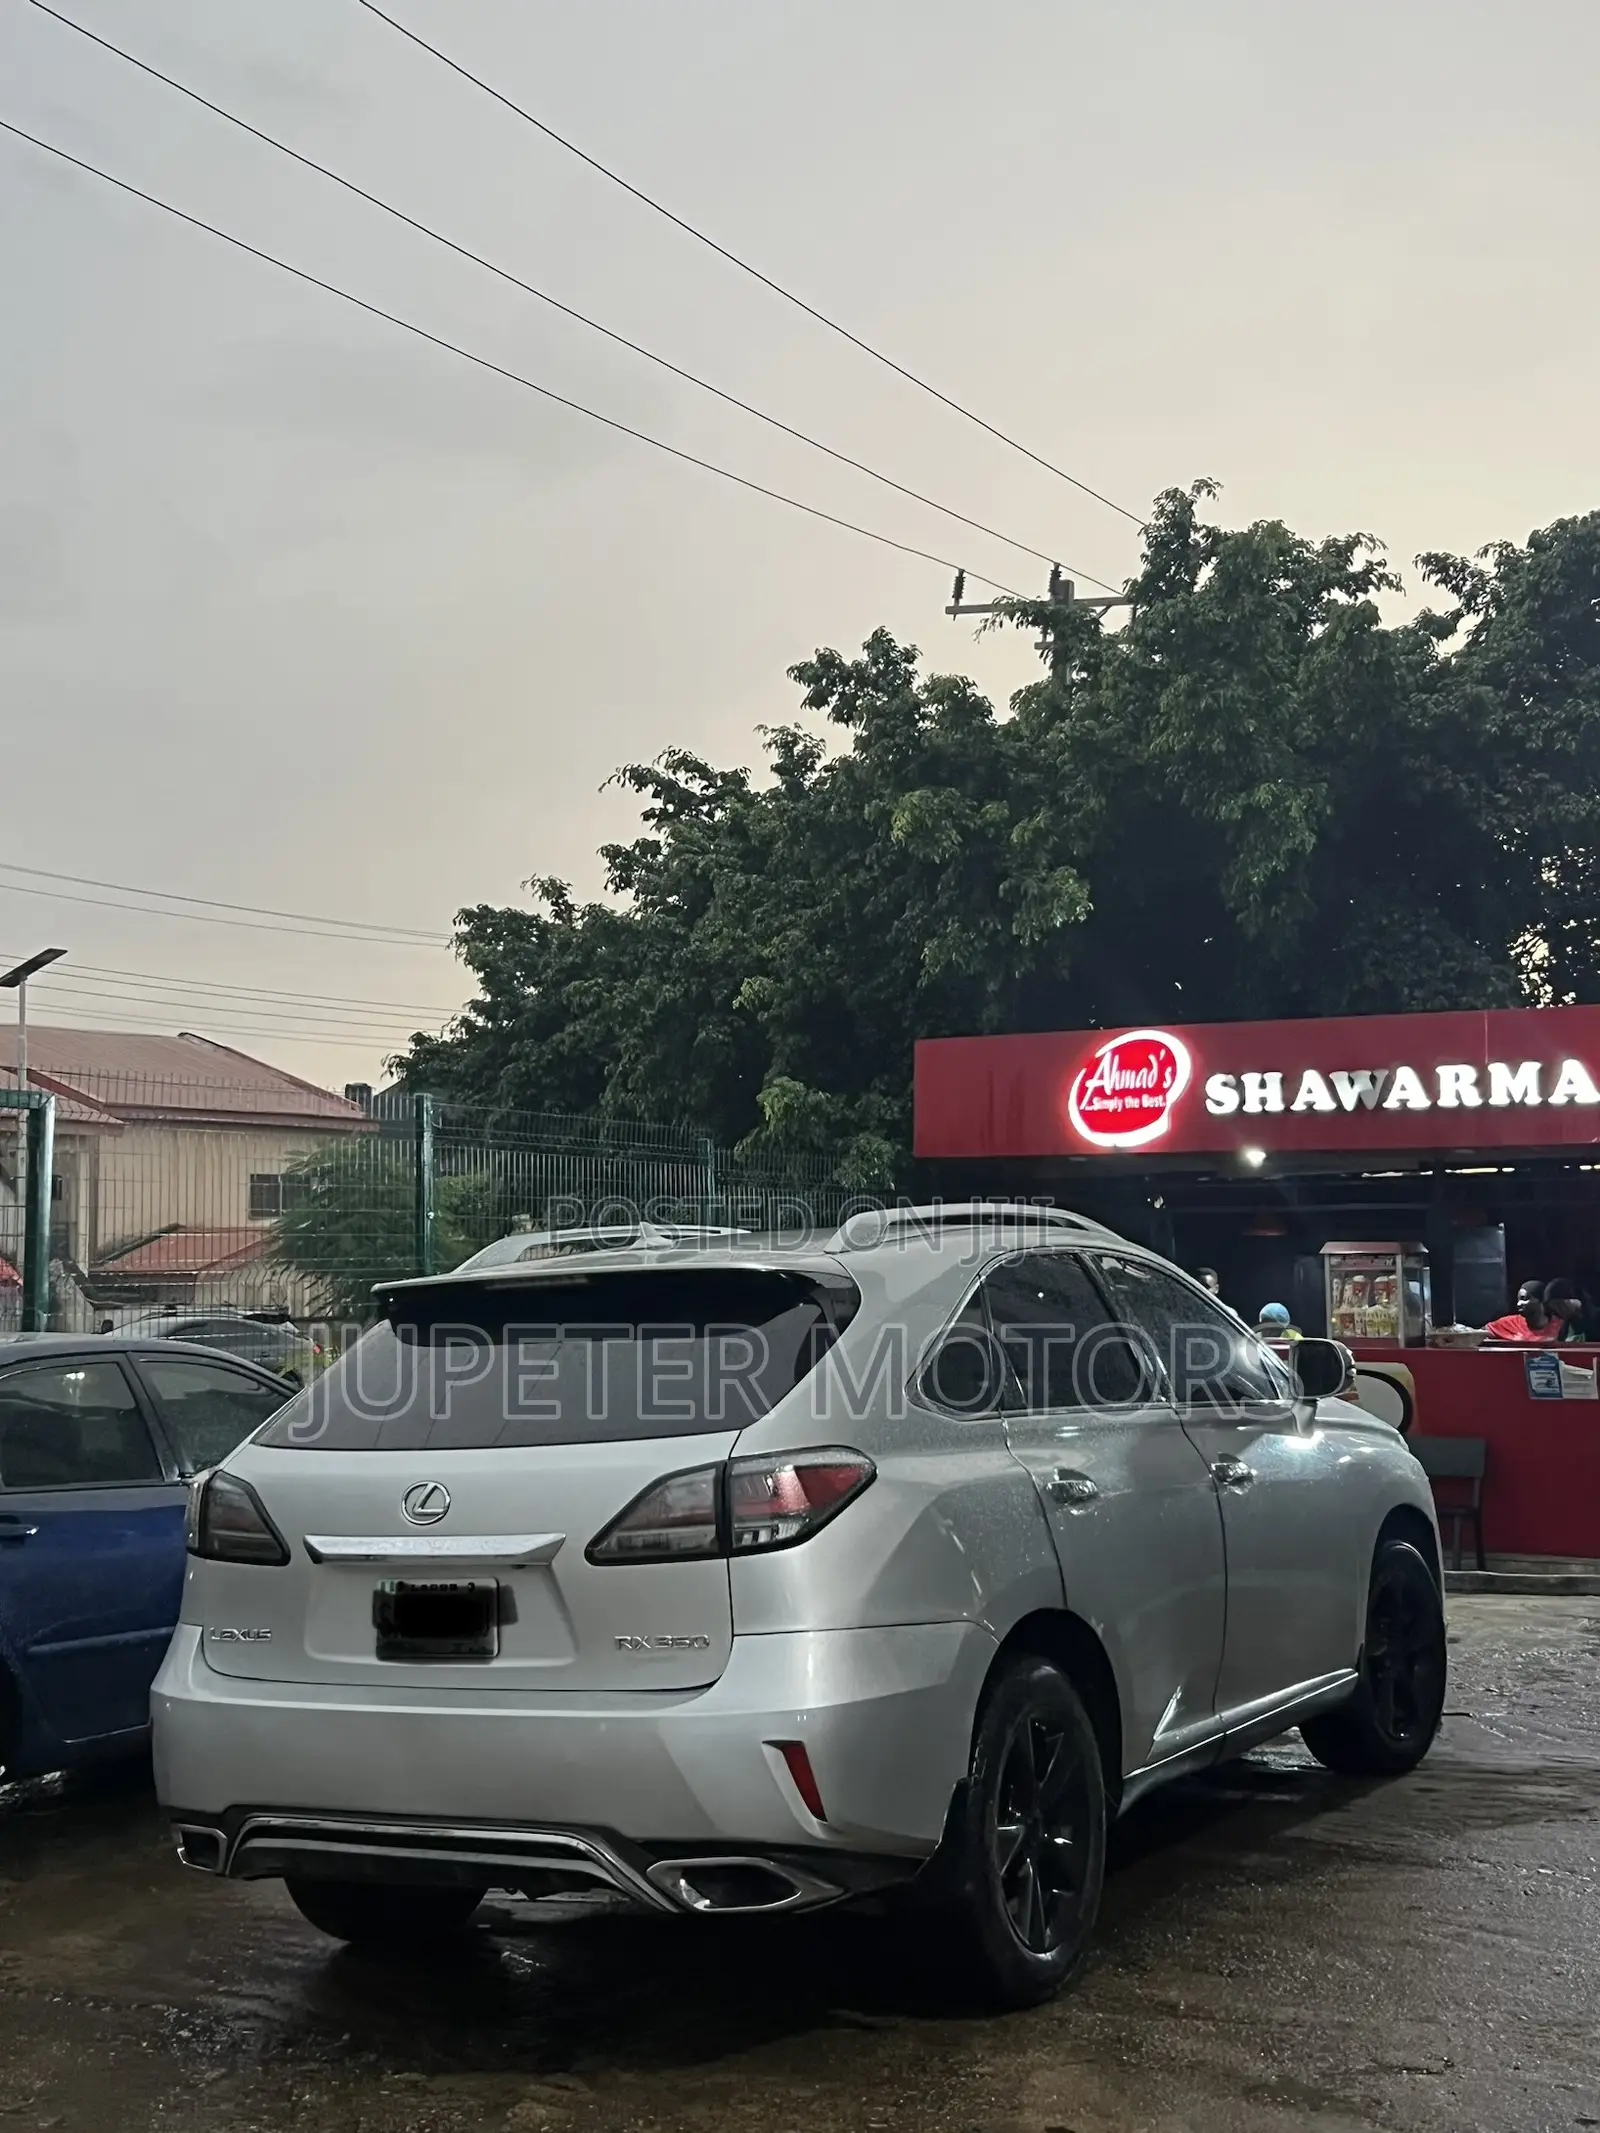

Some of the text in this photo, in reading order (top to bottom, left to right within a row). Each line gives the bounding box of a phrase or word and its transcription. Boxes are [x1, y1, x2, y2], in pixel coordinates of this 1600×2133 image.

[1079, 1049, 1172, 1111] Ahmad's
[1205, 1059, 1600, 1115] SHAWARMA
[1125, 1096, 1140, 1109] the
[209, 1626, 272, 1642] LEXUS
[614, 1634, 711, 1650] RX 350
